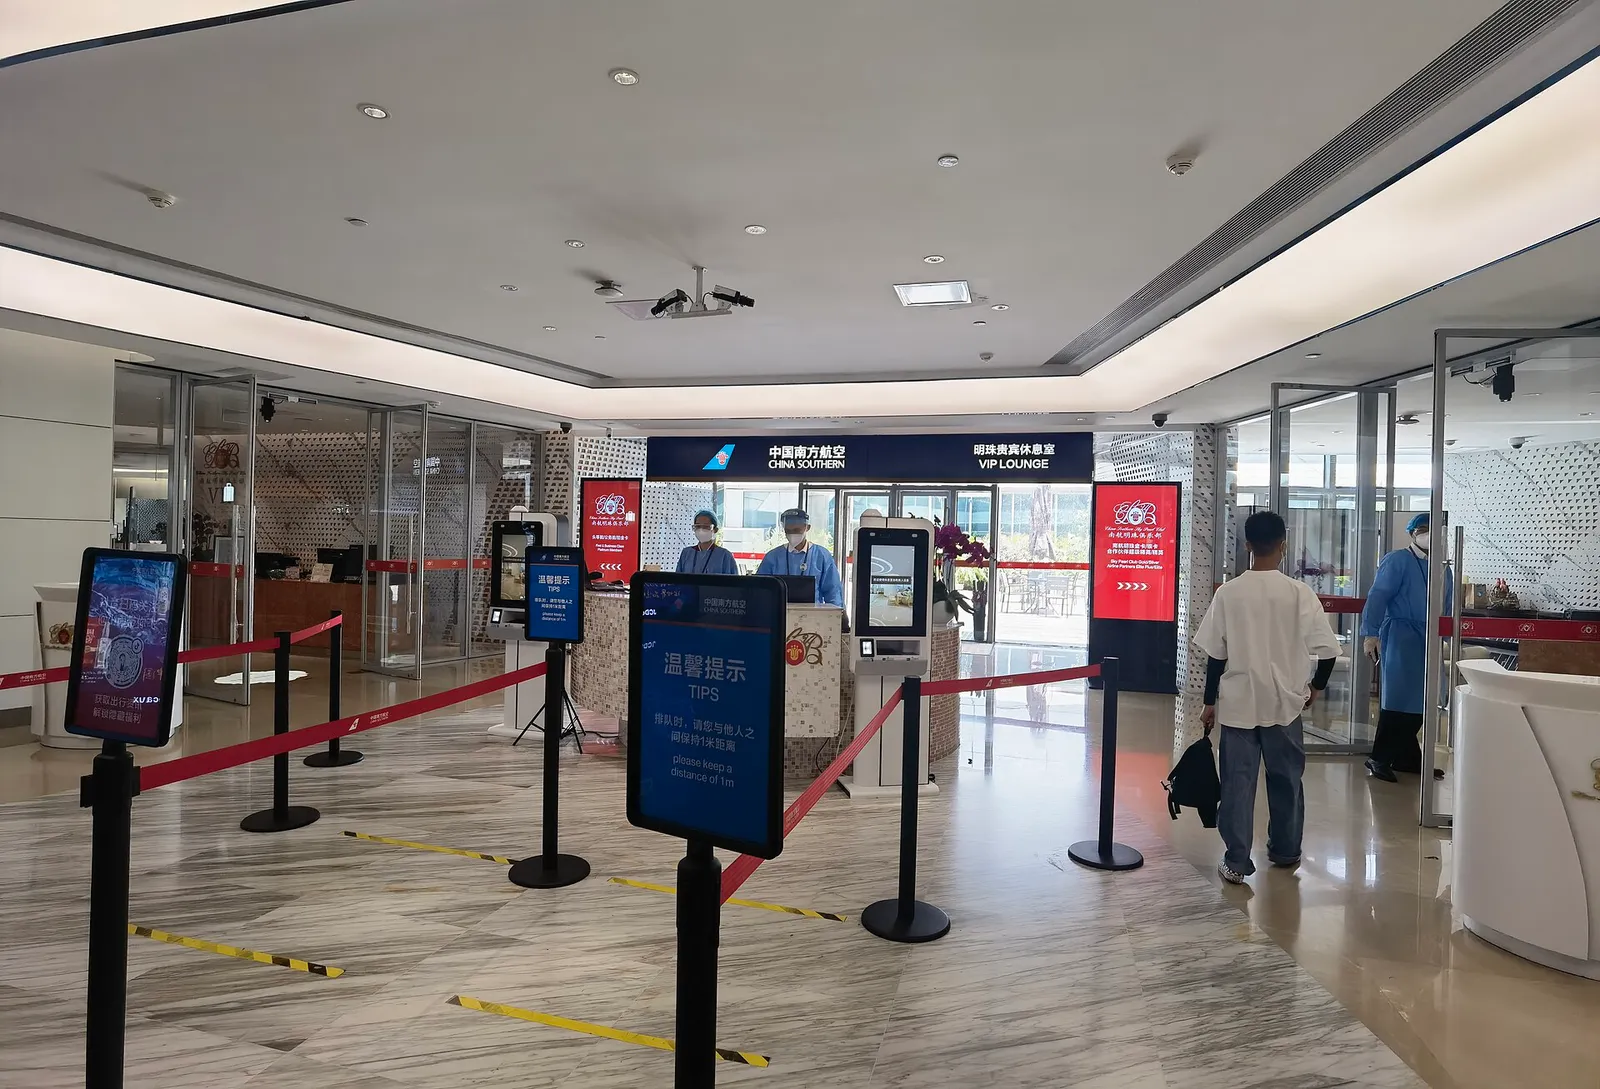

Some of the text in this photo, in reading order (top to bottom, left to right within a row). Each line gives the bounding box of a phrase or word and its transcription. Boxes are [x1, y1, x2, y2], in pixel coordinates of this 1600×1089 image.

[769, 445, 846, 459] 中国南方航空
[973, 443, 1056, 455] 明珠贵宾休息室
[768, 460, 845, 469] CHINA SOUTHERN
[979, 459, 1049, 469] VIP LOUNGE
[538, 574, 570, 585] 温馨提示
[704, 598, 747, 609] 中国南方航空
[664, 652, 747, 682] 温馨提示
[688, 684, 720, 702] TIPS
[671, 730, 736, 752] 间保持1米距离
[672, 754, 733, 774] please keep a
[671, 766, 734, 788] distance of 1m
